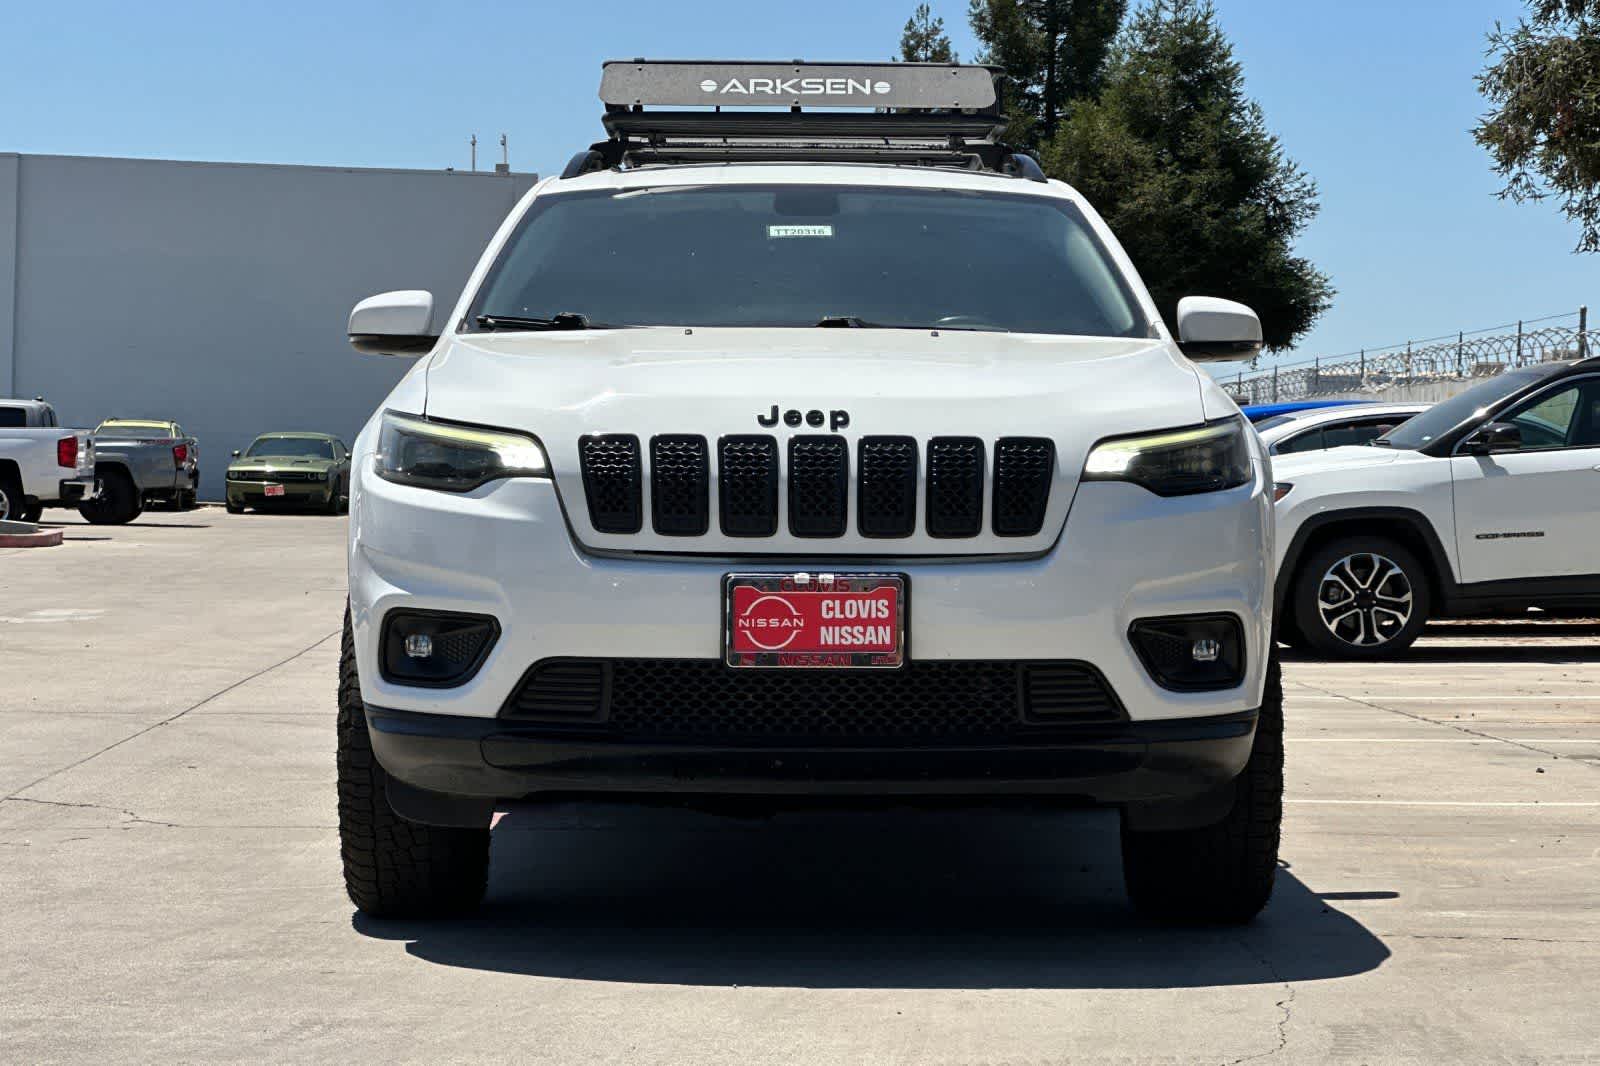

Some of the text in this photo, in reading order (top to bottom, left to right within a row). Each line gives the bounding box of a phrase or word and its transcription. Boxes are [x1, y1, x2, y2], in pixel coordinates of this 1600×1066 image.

[719, 78, 871, 95] ARKSEN
[757, 405, 850, 432] Jeep
[821, 599, 890, 619] CLOVIS
[738, 618, 804, 628] NISSAN
[820, 626, 891, 645] NISSAN
